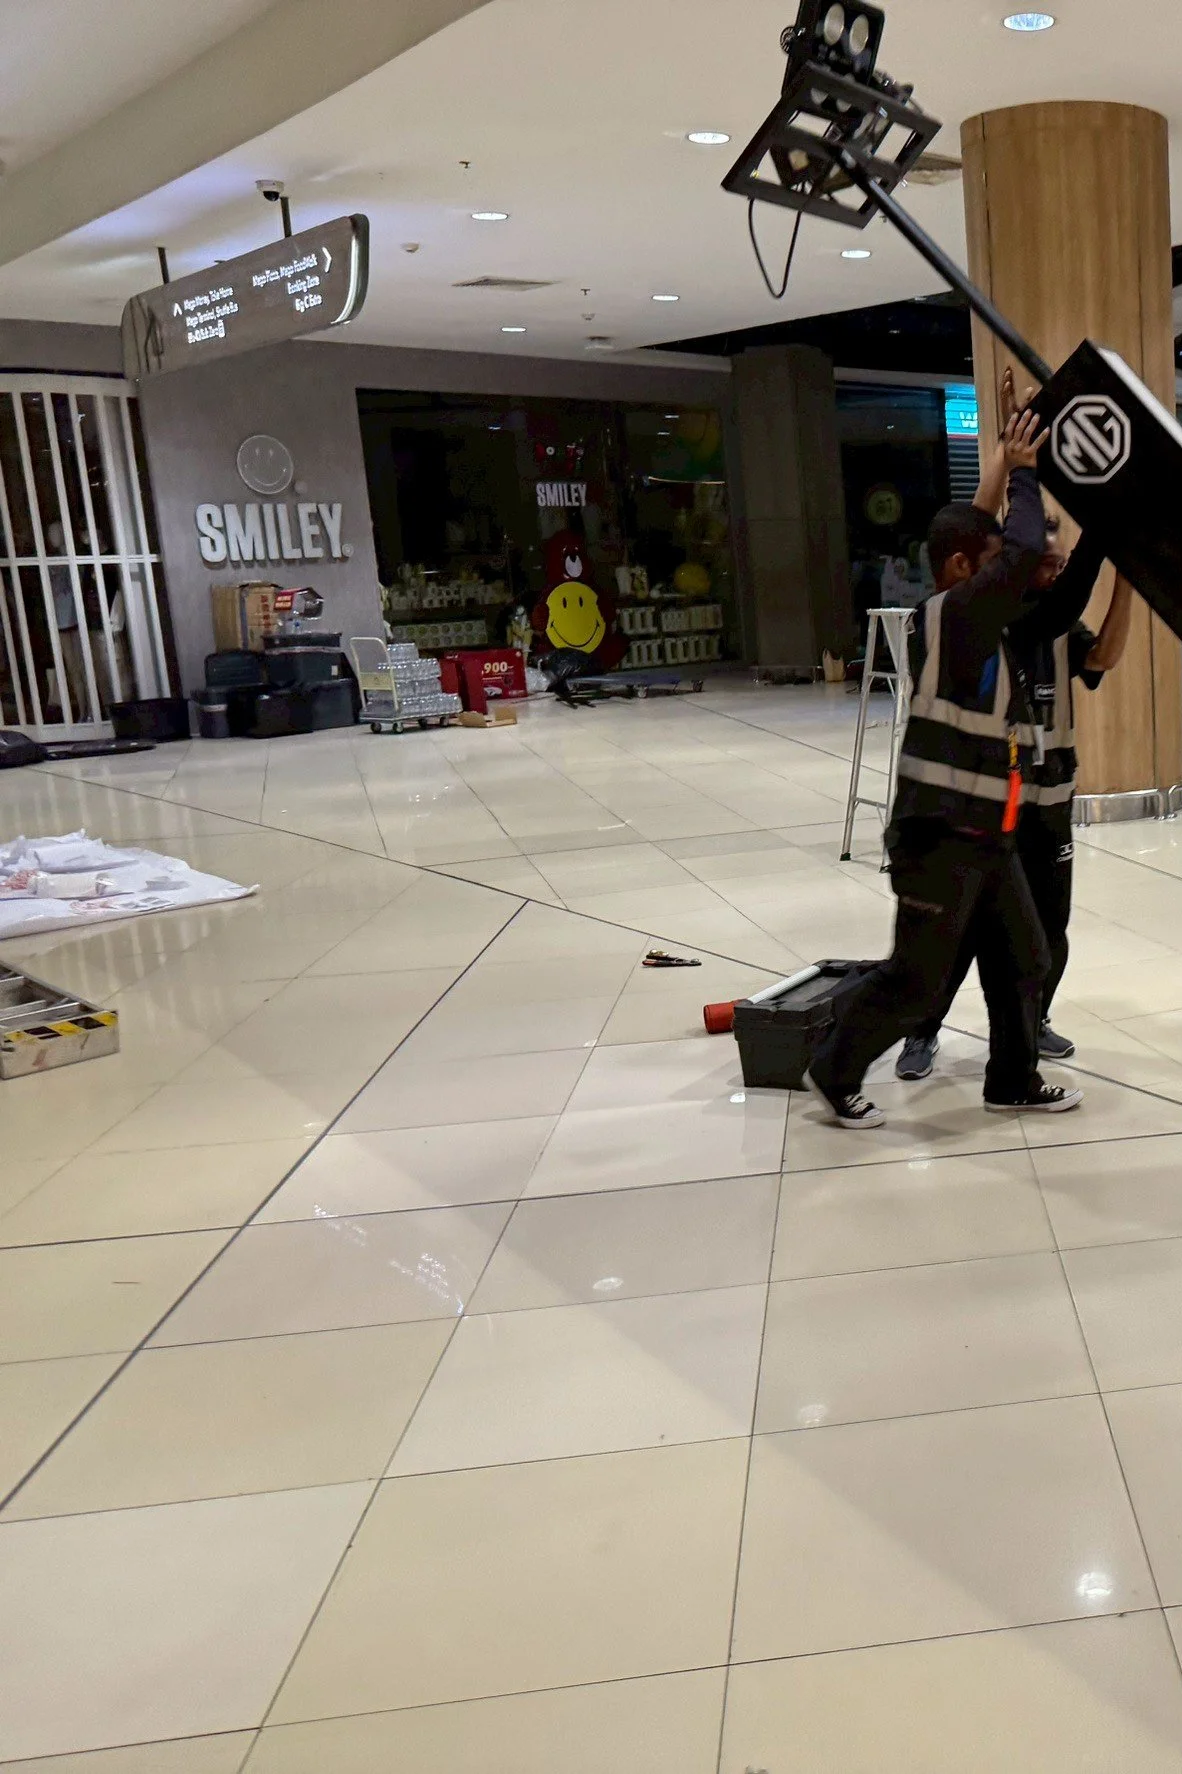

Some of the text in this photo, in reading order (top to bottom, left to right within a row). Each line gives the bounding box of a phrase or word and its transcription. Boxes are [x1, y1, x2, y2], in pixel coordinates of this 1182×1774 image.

[1060, 404, 1122, 474] MG
[536, 482, 587, 506] SMILEY
[195, 502, 343, 563] SMILEY
